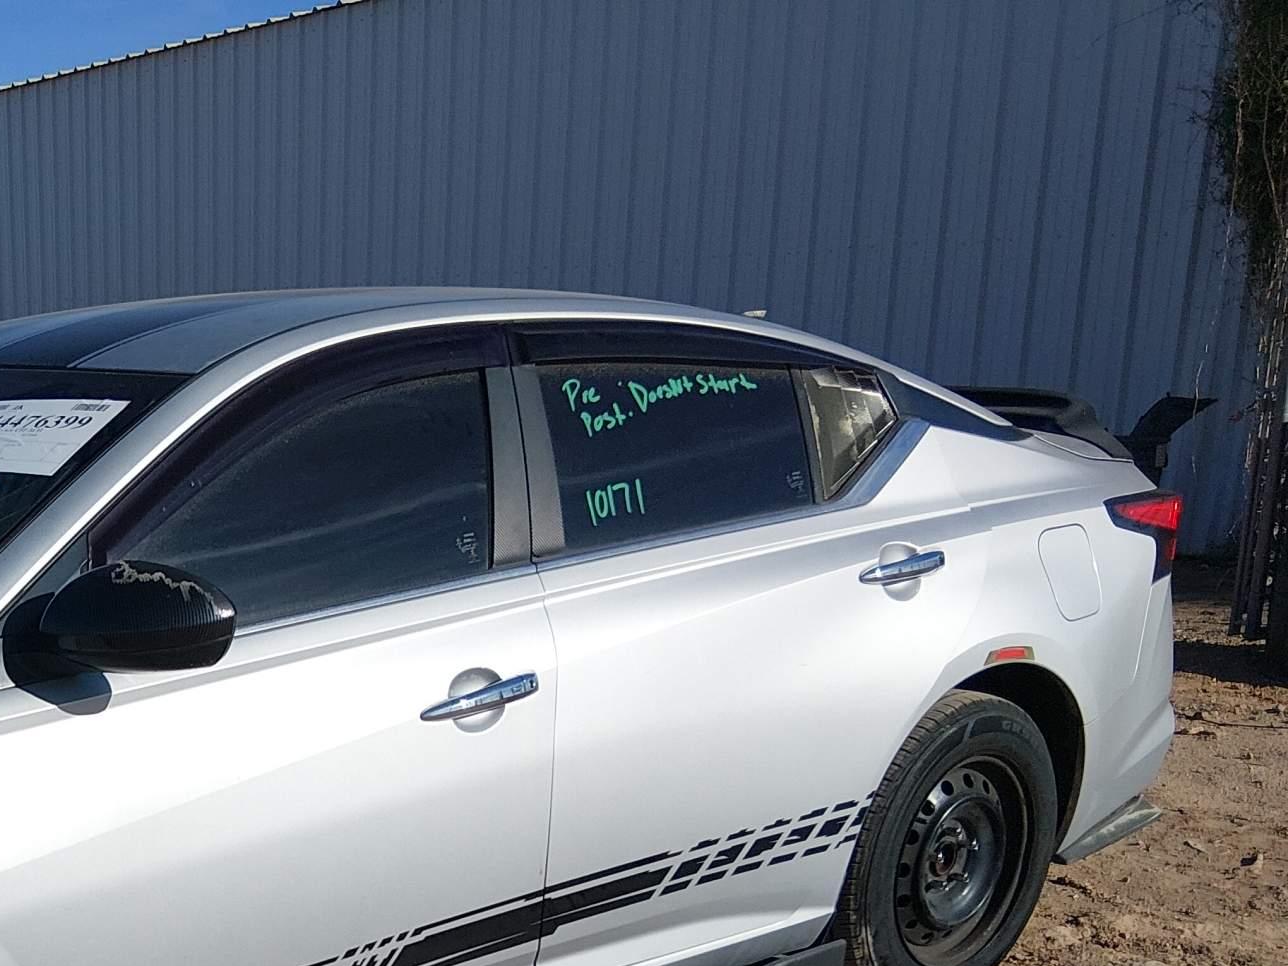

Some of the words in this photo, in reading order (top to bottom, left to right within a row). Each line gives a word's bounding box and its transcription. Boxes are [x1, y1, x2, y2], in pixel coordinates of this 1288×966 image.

[561, 378, 601, 412] Pre
[696, 372, 758, 395] Start
[585, 478, 645, 527] 10171
